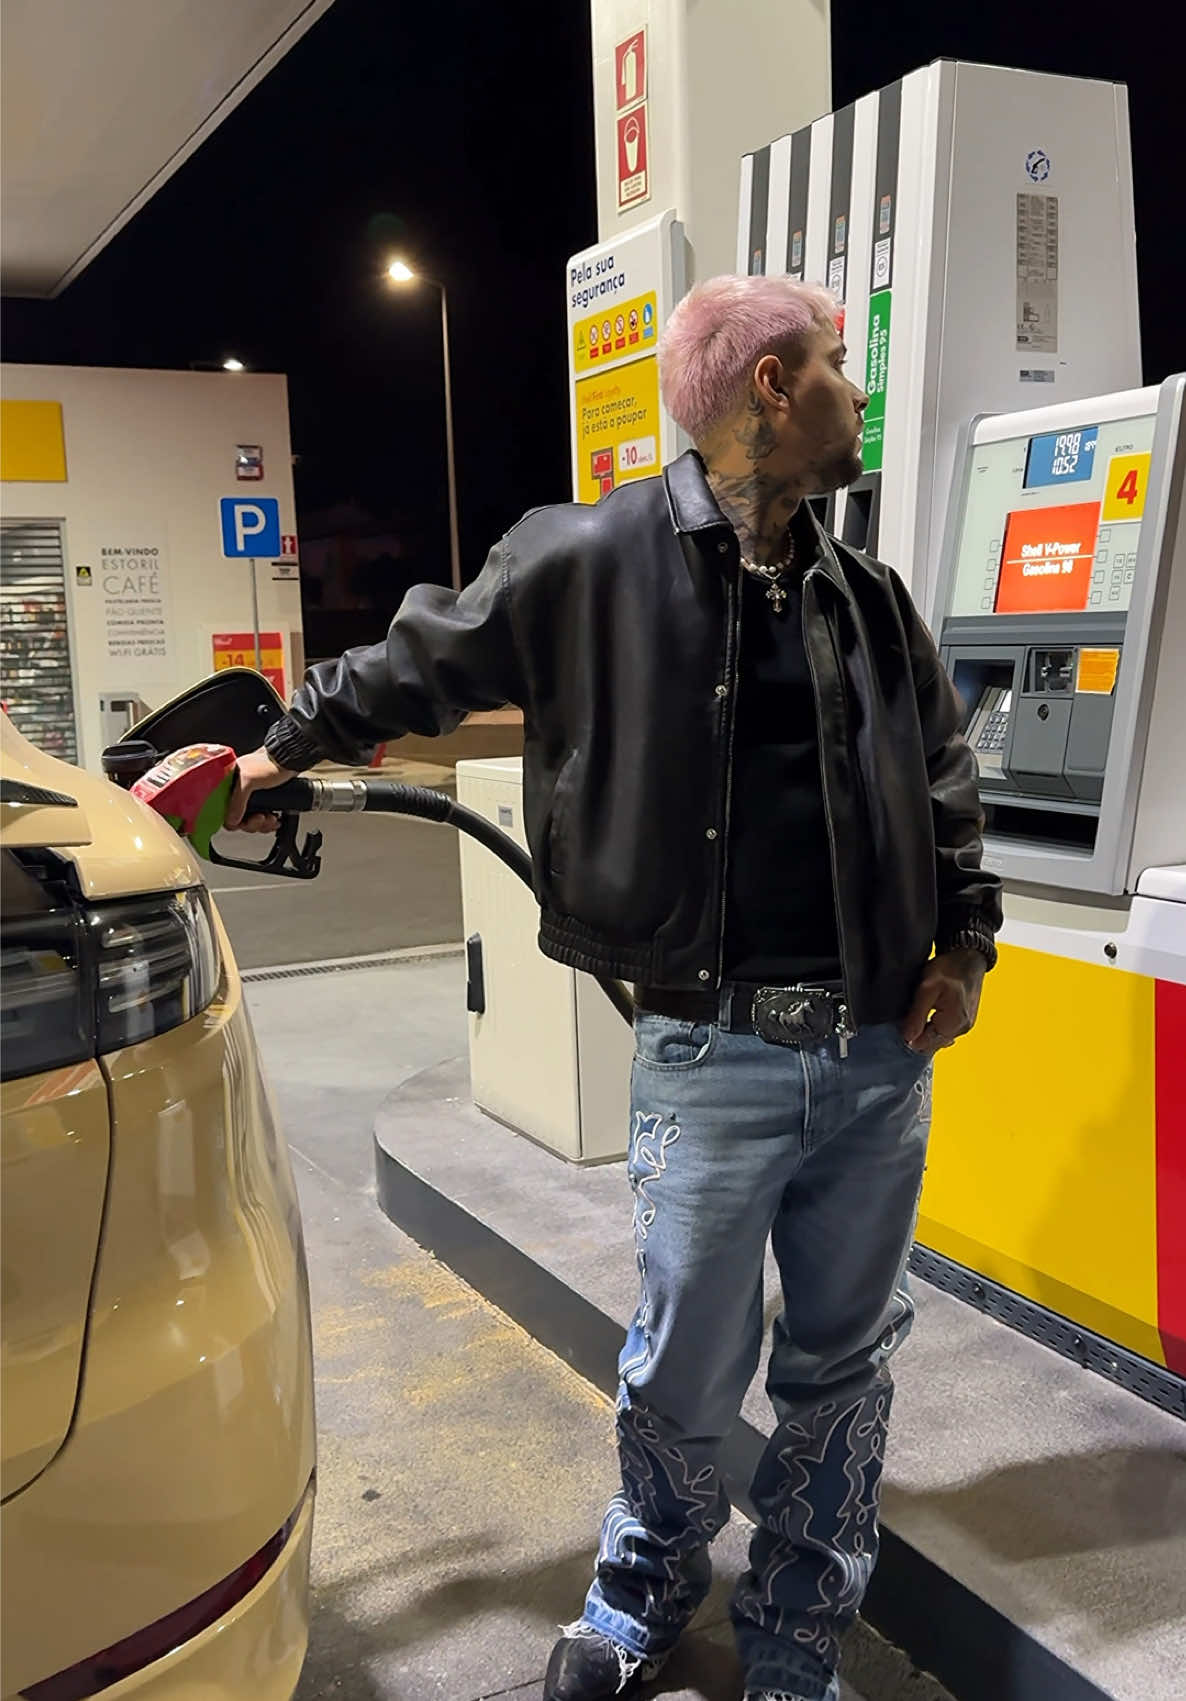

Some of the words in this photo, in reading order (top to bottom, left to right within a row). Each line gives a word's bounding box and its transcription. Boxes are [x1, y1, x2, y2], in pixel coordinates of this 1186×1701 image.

[571, 262, 592, 288] Pela
[596, 255, 614, 276] sua
[572, 272, 625, 308] segurança
[879, 329, 887, 345] 95
[868, 314, 880, 395] Gasolina
[877, 345, 888, 392] Simples
[583, 407, 600, 419] Para
[616, 409, 647, 430] poupar
[1116, 469, 1138, 505] 4
[234, 504, 266, 551] P
[1021, 544, 1043, 558] Shell
[1045, 542, 1081, 556] V-Power
[101, 558, 159, 570] ESTORIL
[1022, 562, 1060, 576] Gasolina
[103, 571, 159, 595] CAFÉ
